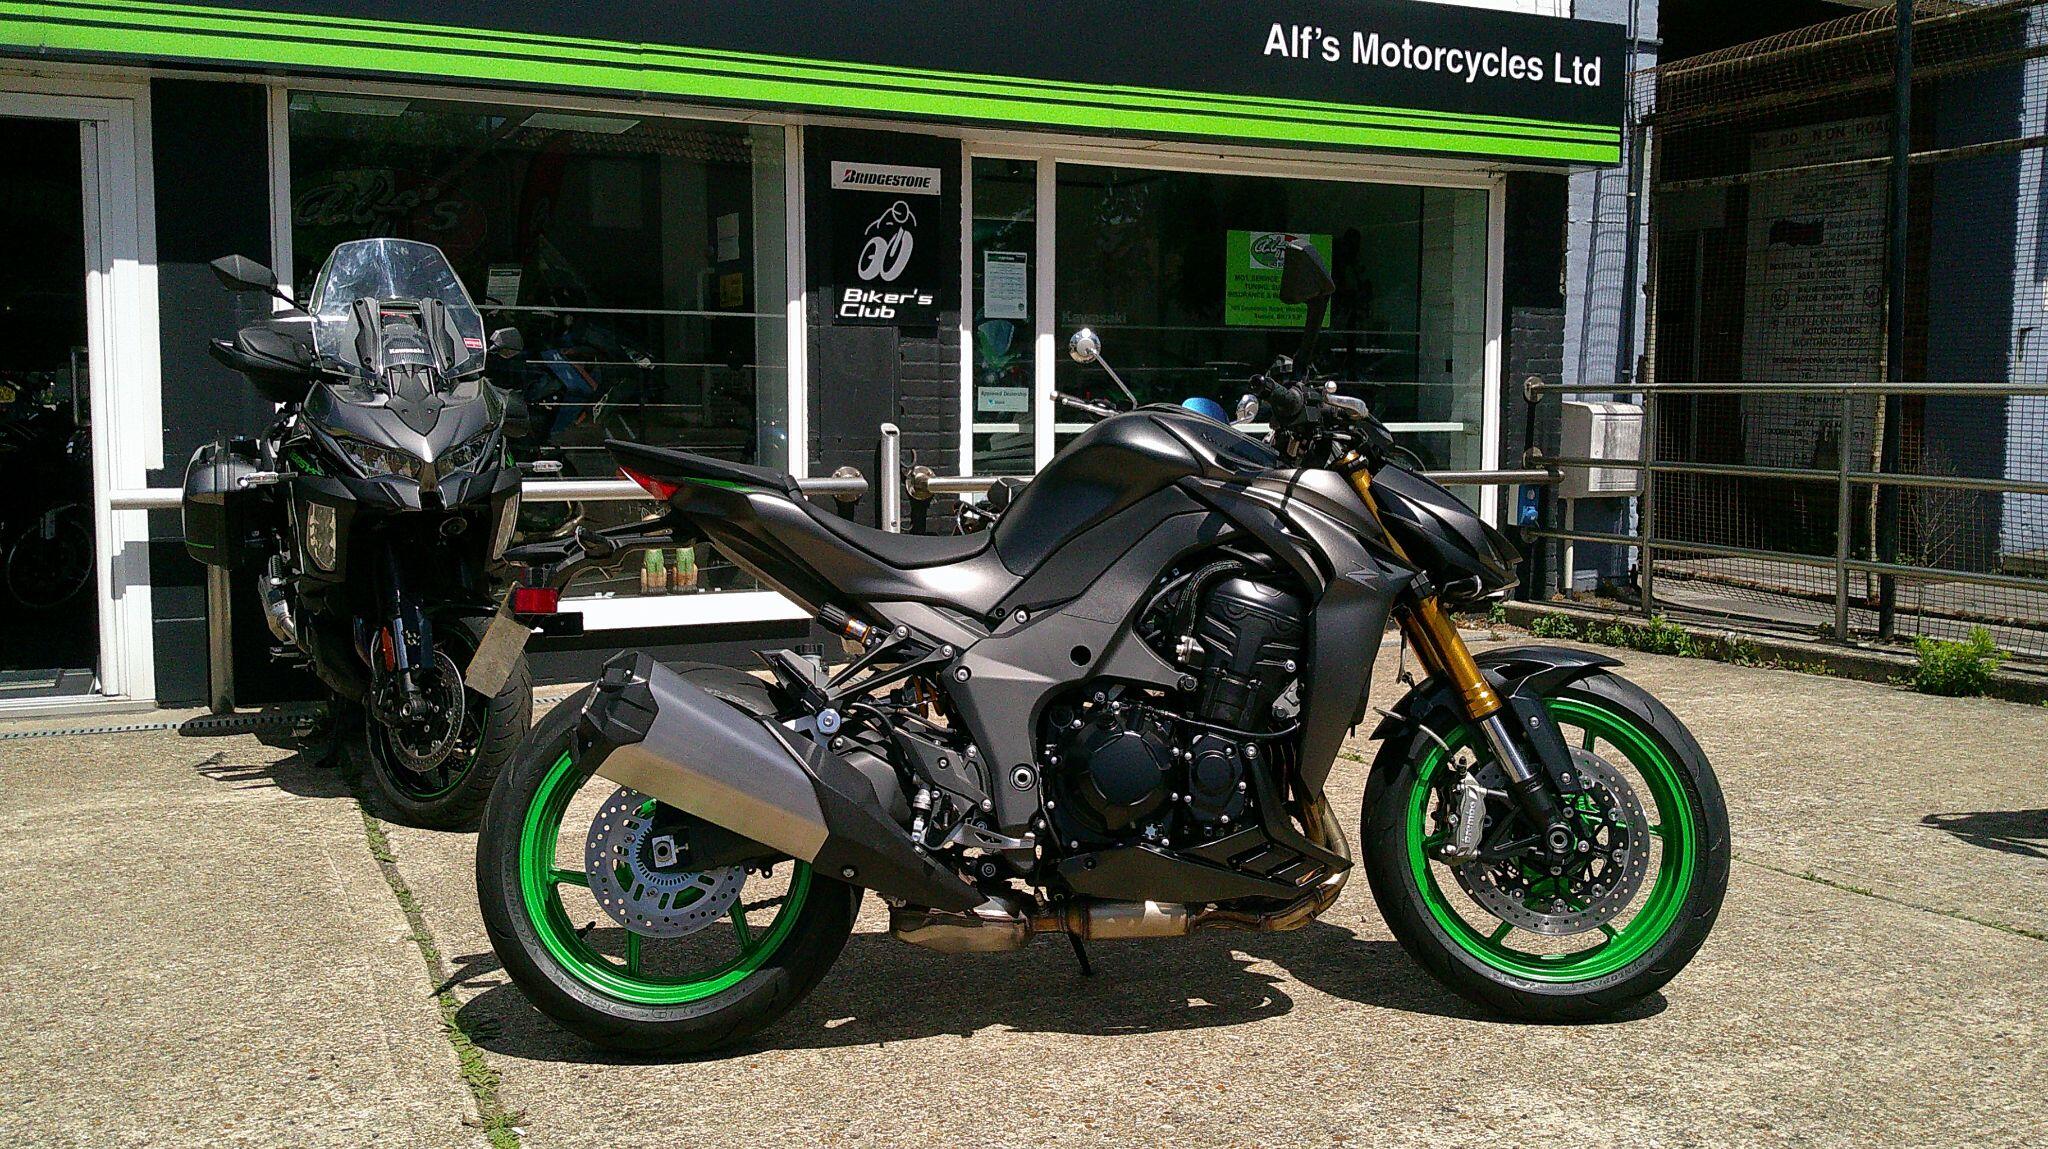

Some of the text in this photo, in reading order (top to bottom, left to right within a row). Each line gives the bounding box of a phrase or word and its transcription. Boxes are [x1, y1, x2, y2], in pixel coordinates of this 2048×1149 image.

[1264, 22, 1601, 86] Alf's Motorcycles Ltd
[842, 169, 932, 188] BRIDGESTONE
[843, 288, 933, 305] Biker's
[840, 303, 896, 319] Club
